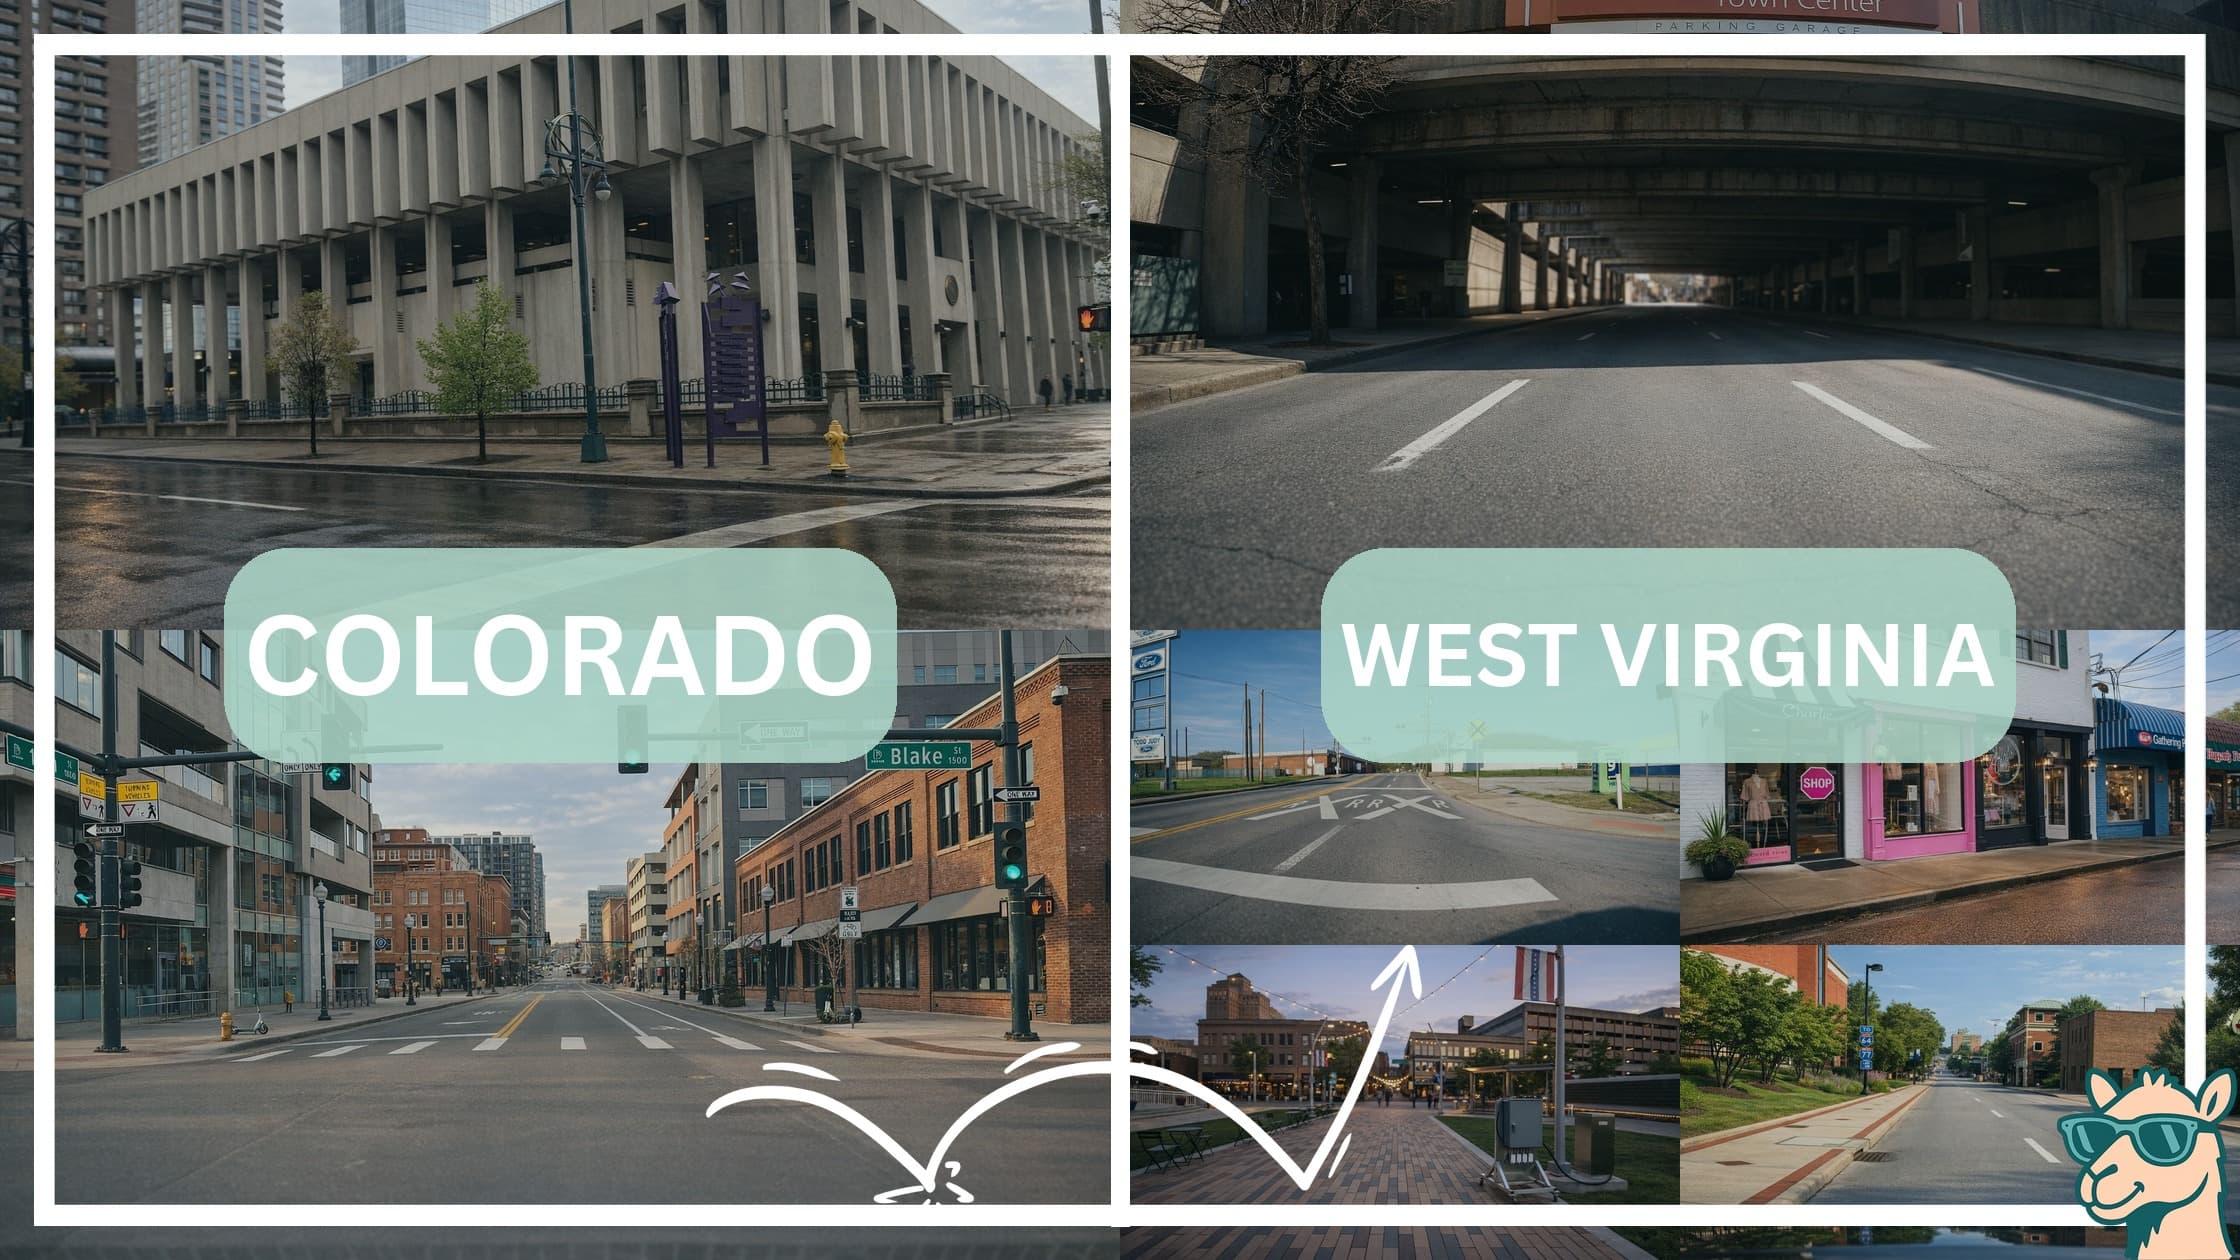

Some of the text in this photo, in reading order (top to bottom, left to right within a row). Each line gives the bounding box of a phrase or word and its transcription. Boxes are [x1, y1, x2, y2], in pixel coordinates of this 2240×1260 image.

[1655, 22, 1756, 31] PARKING
[2153, 734, 2182, 750] Gathering
[891, 746, 943, 765] Blake
[1803, 777, 1832, 789] SHOP
